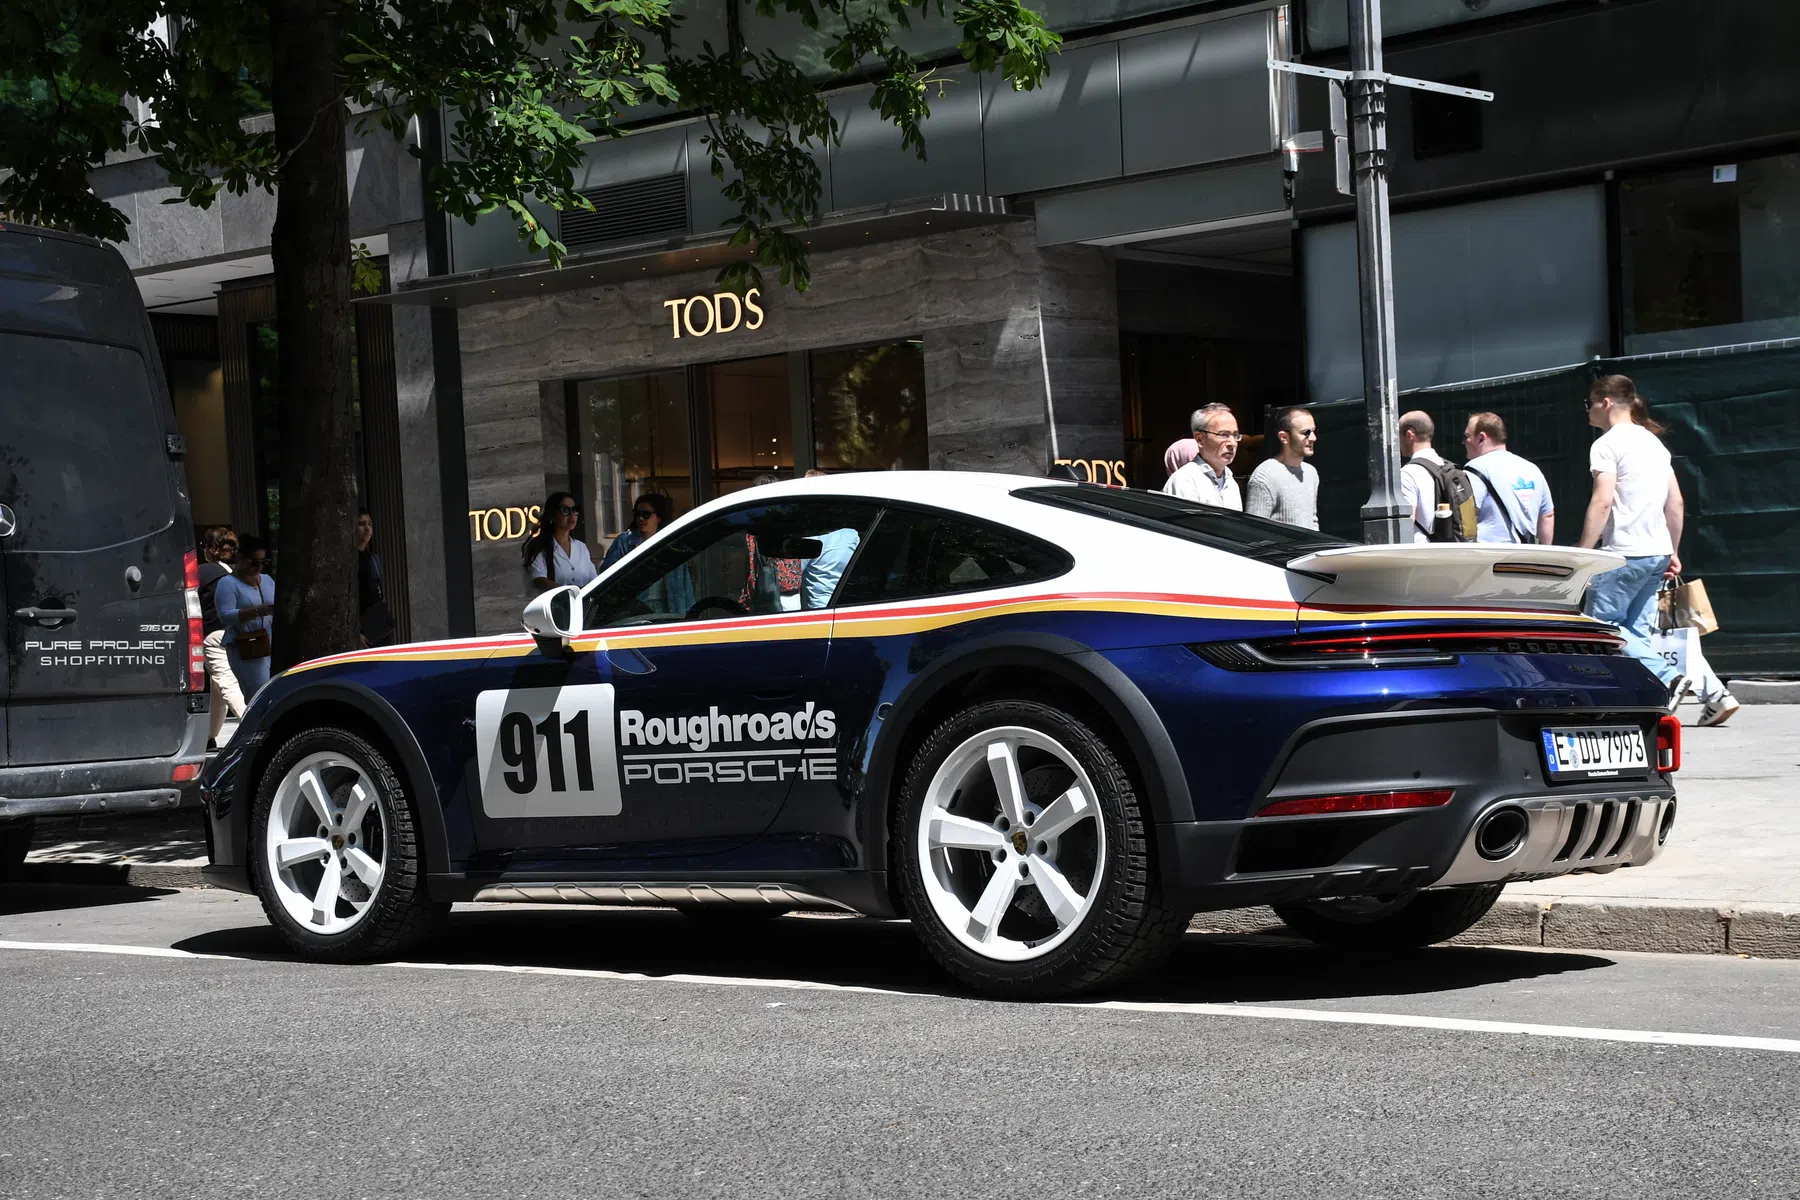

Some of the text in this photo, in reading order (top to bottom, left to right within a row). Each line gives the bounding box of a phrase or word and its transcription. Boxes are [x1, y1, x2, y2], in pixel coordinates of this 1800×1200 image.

[663, 288, 764, 339] TOD'S
[468, 505, 541, 541] TOD'S
[161, 624, 180, 632] CDI
[25, 640, 176, 651] PURE PROJECT
[40, 655, 165, 666] SHOPFITTING
[1656, 651, 1679, 667] ES
[619, 701, 837, 752] Roughroads
[500, 709, 595, 795] 911
[1554, 730, 1644, 766] E DD 7993
[623, 757, 837, 785] PORSCHE
